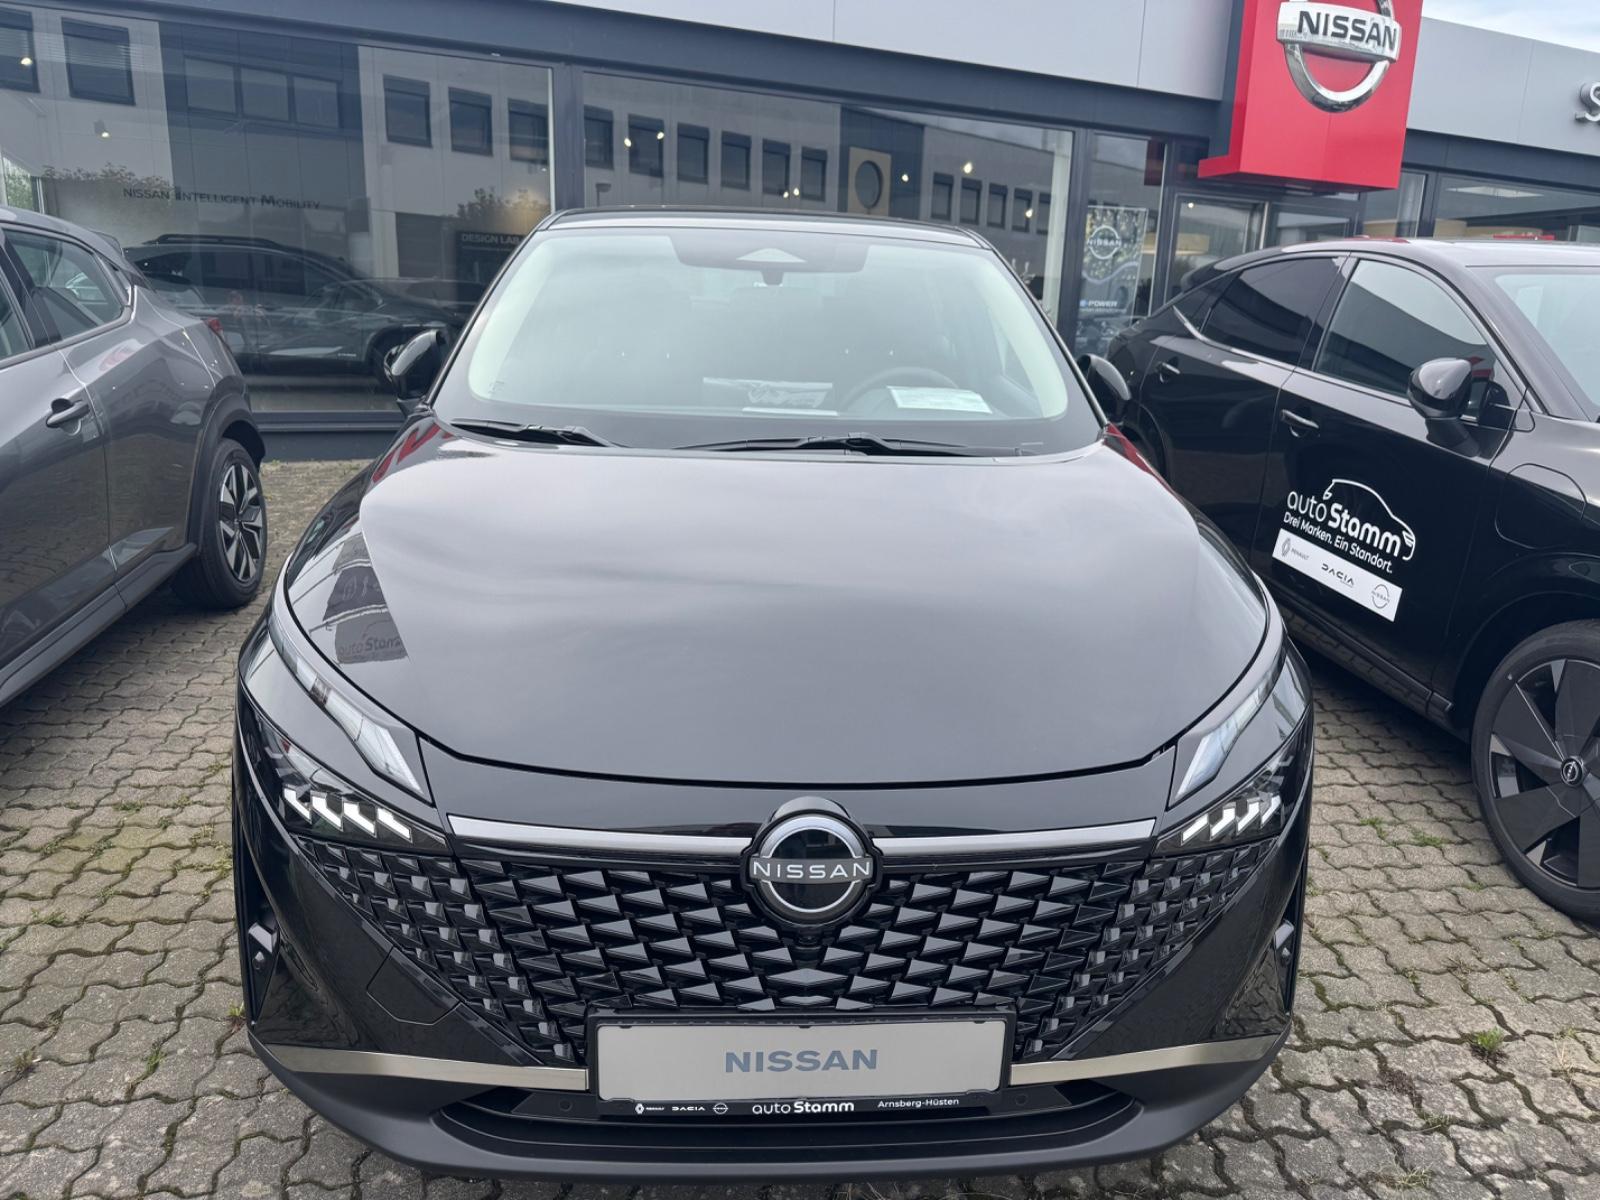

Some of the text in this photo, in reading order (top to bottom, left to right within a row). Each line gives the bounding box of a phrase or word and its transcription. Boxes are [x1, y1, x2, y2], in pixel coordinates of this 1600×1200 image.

[1297, 10, 1397, 51] NISSAN
[123, 187, 170, 200] NISSAN
[177, 188, 257, 205] INTELLIGENT
[461, 233, 499, 243] DESIGN
[1283, 512, 1393, 573] Drei Marken. Ein Standort.
[753, 861, 870, 879] NISSAN
[725, 1049, 878, 1073] NISSAN
[877, 1098, 959, 1108] Arnsberg-Hüsten
